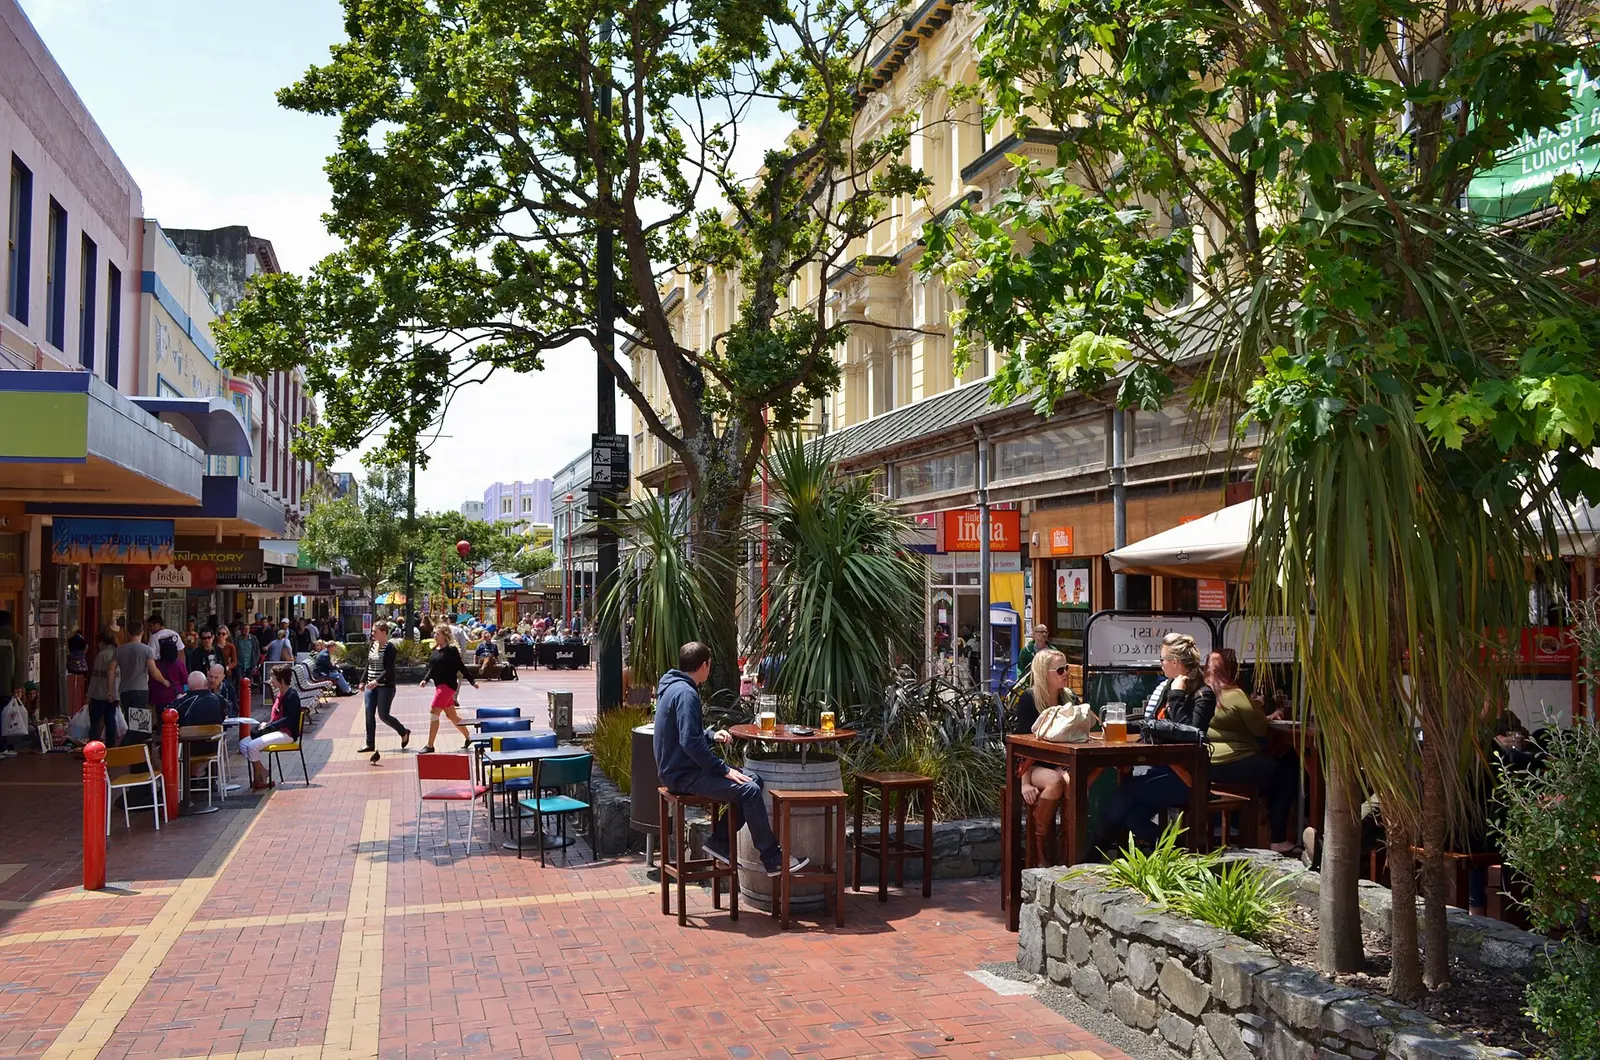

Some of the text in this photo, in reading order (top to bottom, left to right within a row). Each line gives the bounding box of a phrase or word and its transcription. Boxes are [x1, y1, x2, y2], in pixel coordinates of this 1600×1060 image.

[1521, 136, 1584, 175] LUNCH
[70, 533, 172, 546] HOMESTEAD HEALTH
[173, 553, 244, 562] ANDATORY
